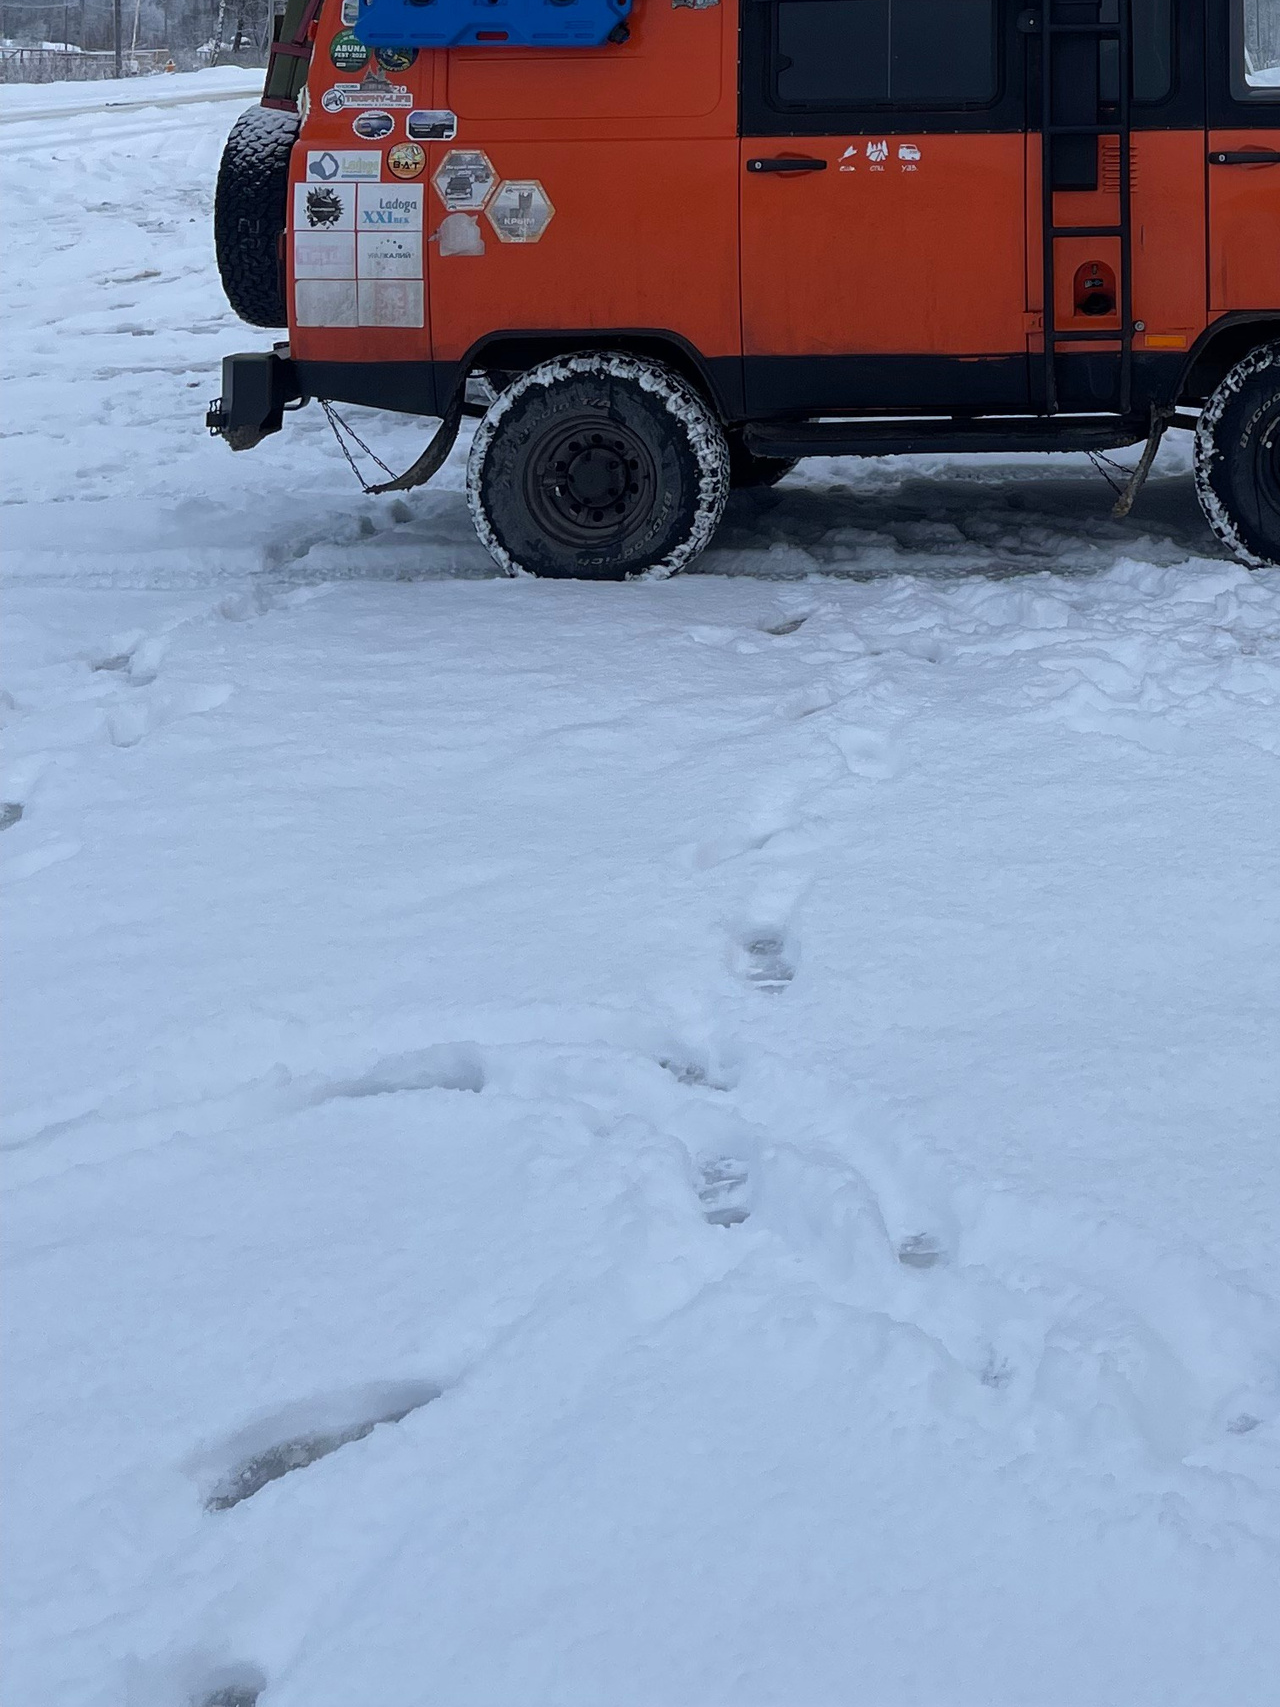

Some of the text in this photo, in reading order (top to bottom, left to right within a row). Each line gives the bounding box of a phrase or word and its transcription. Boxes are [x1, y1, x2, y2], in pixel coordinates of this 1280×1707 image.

[379, 198, 417, 213] Ladoga
[504, 217, 535, 226] КРЫМ
[577, 491, 673, 566] BFGoodrich
